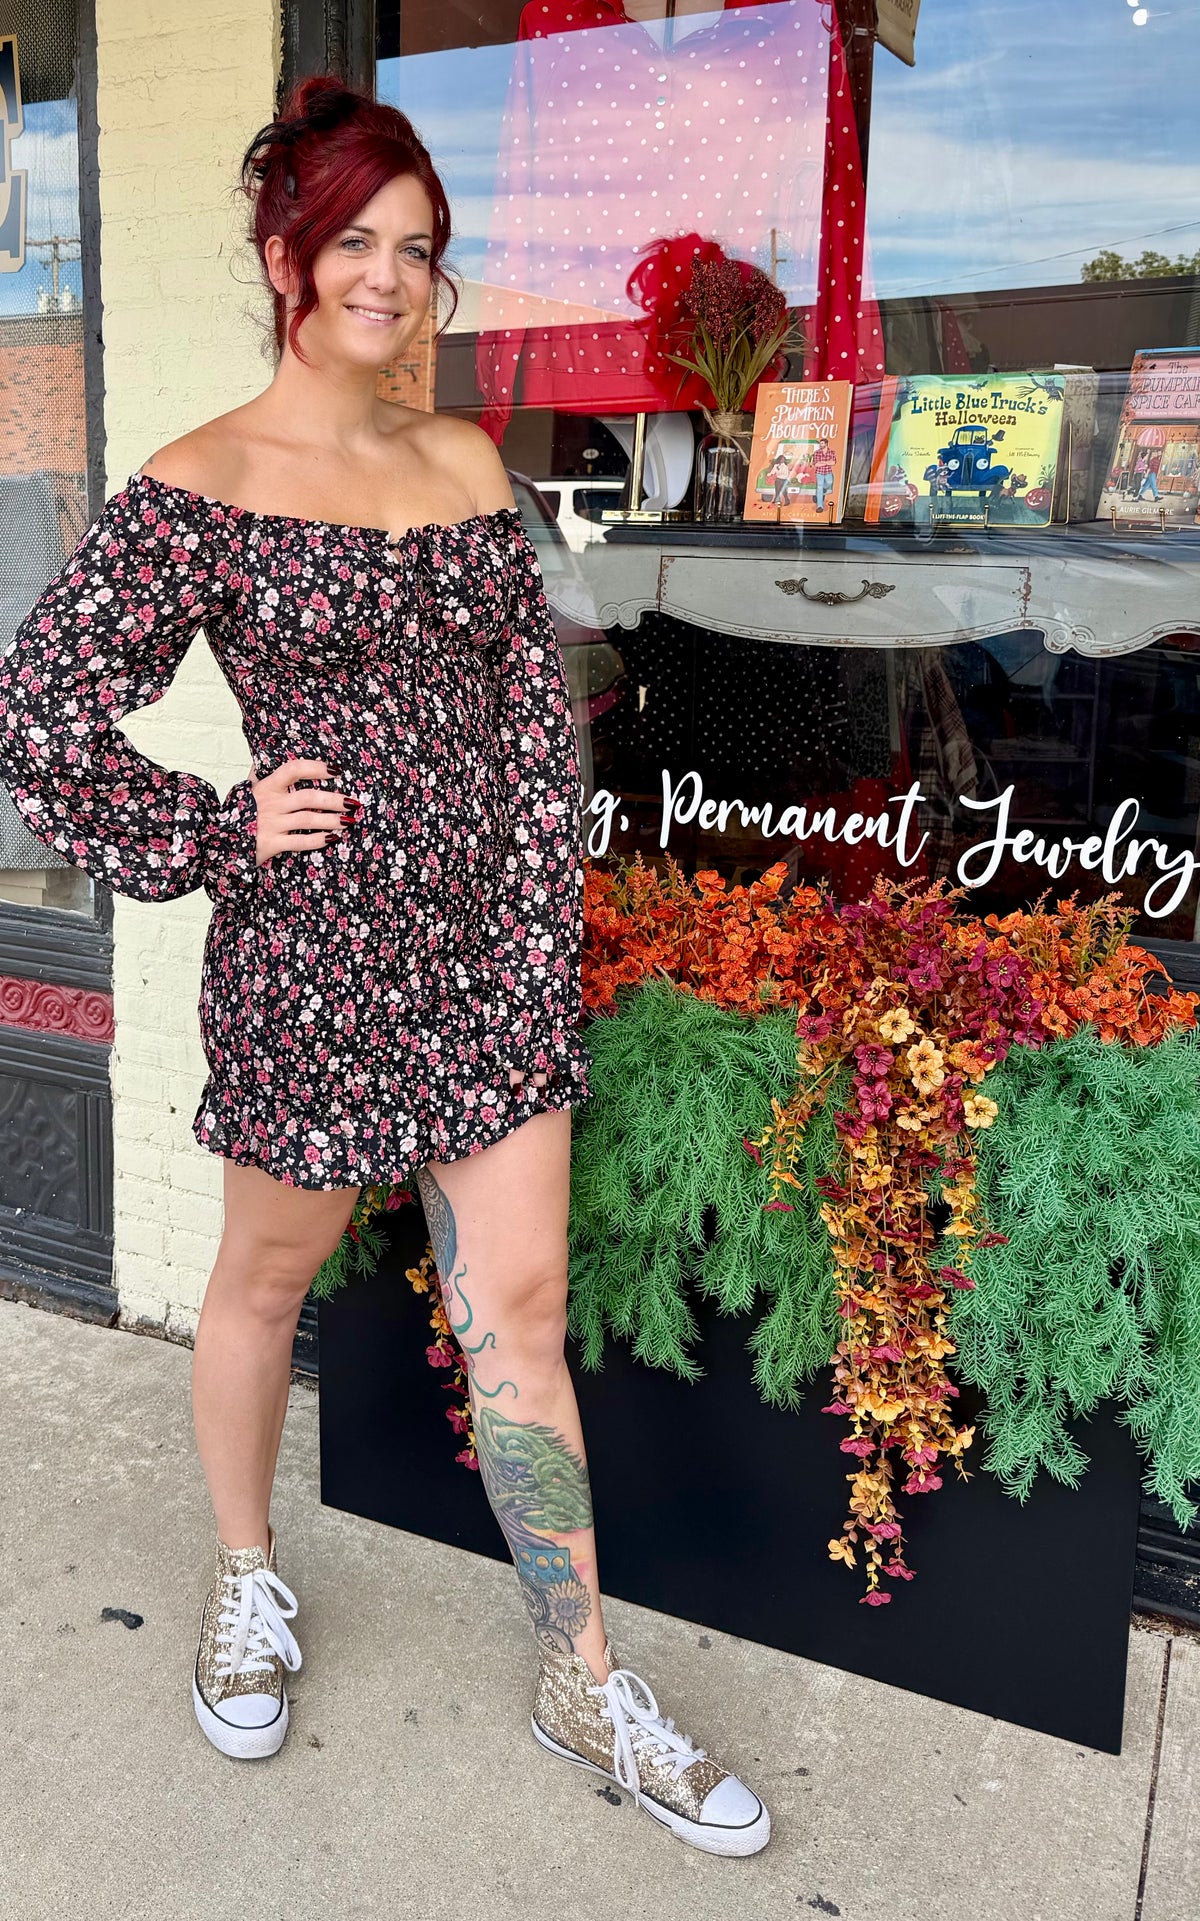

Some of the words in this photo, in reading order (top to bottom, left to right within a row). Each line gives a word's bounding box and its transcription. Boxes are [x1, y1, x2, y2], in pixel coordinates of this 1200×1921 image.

[1168, 361, 1188, 374] The
[1142, 376, 1200, 392] PUMPKI
[781, 386, 830, 404] THERE'S
[911, 395, 951, 414] Little
[955, 392, 988, 410] Blue
[991, 392, 1048, 415] Truck's
[1130, 394, 1170, 409] SPICE
[771, 404, 835, 423] PUMPKIN
[935, 411, 1017, 426] Halloween
[761, 423, 808, 441] ABOUT
[809, 422, 838, 439] YOU
[1114, 506, 1140, 514] AURIE
[1141, 507, 1175, 515] GILMRE
[659, 769, 930, 867] Permanent
[957, 784, 1200, 919] Jewelry
